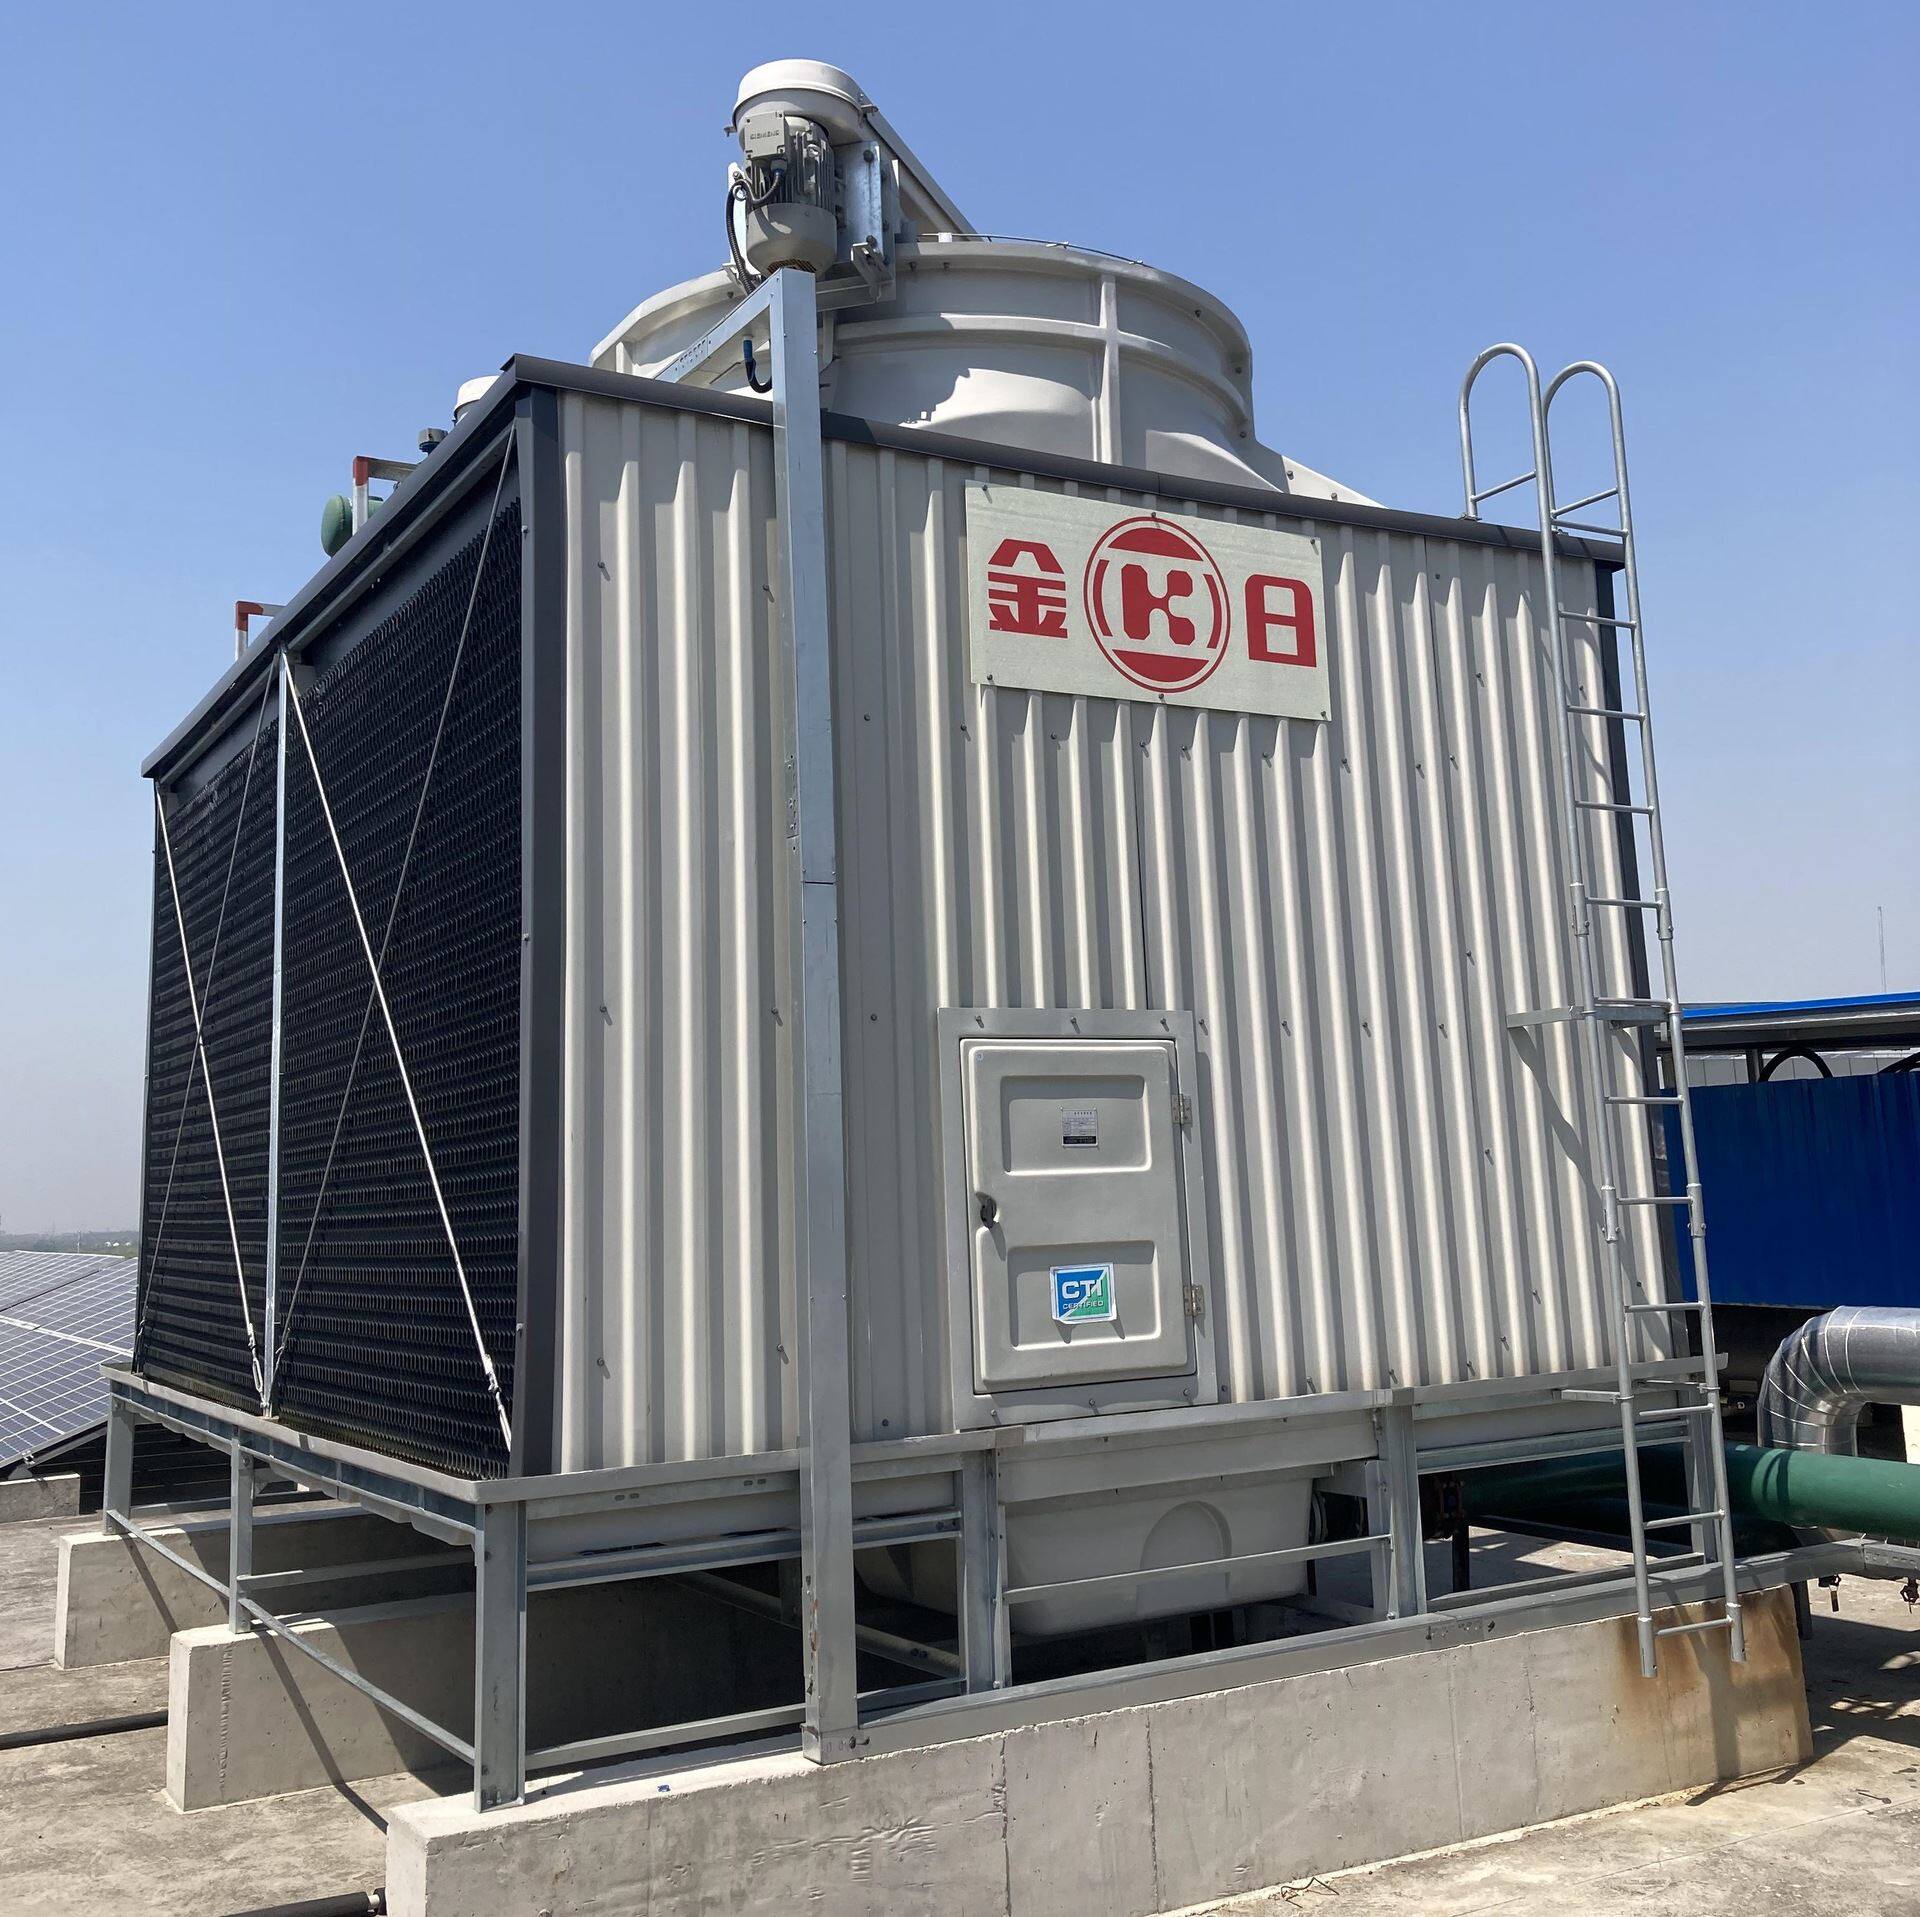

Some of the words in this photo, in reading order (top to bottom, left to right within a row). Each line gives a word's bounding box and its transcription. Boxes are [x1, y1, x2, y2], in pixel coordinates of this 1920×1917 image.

[987, 538, 1068, 639] 金
[1121, 563, 1196, 646] K
[1245, 574, 1317, 668] 日
[1062, 1279, 1102, 1299] CTI
[1063, 1301, 1103, 1310] CERTIFIED
